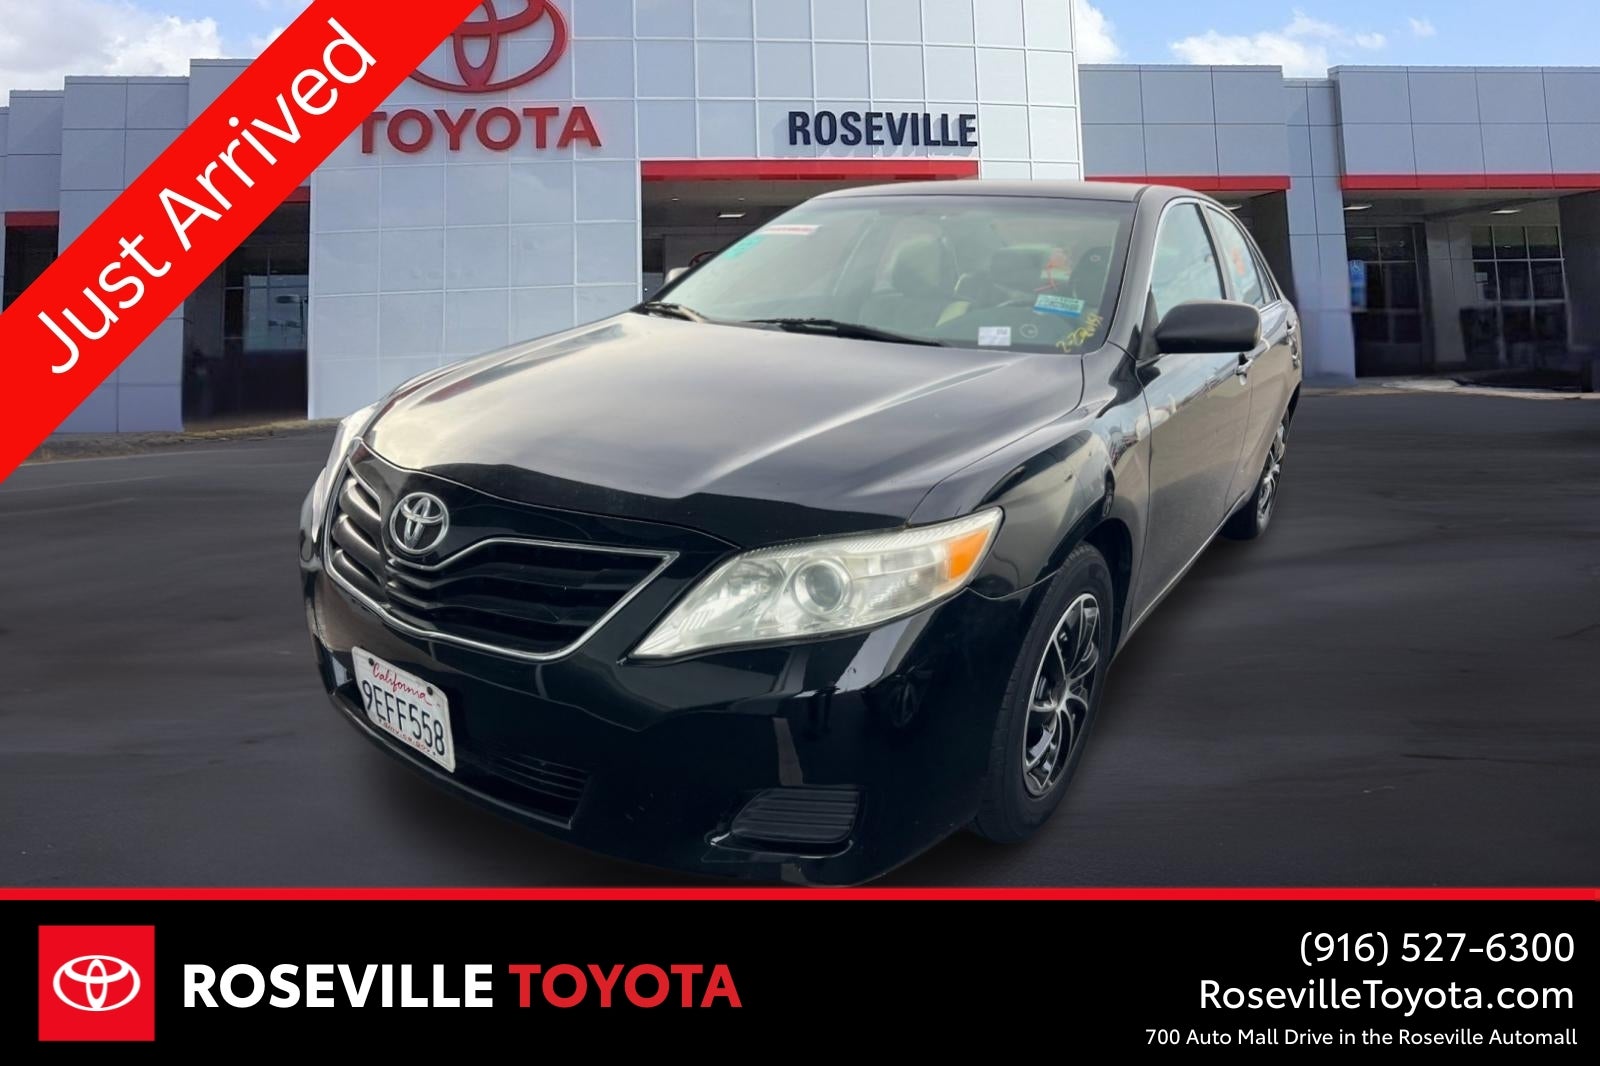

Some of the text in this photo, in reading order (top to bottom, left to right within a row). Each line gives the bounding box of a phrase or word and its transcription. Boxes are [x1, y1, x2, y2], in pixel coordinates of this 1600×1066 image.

[361, 107, 602, 154] TOYOTA
[788, 110, 978, 147] ROSEVILLE
[372, 662, 433, 706] California
[361, 679, 446, 756] 9EFF558
